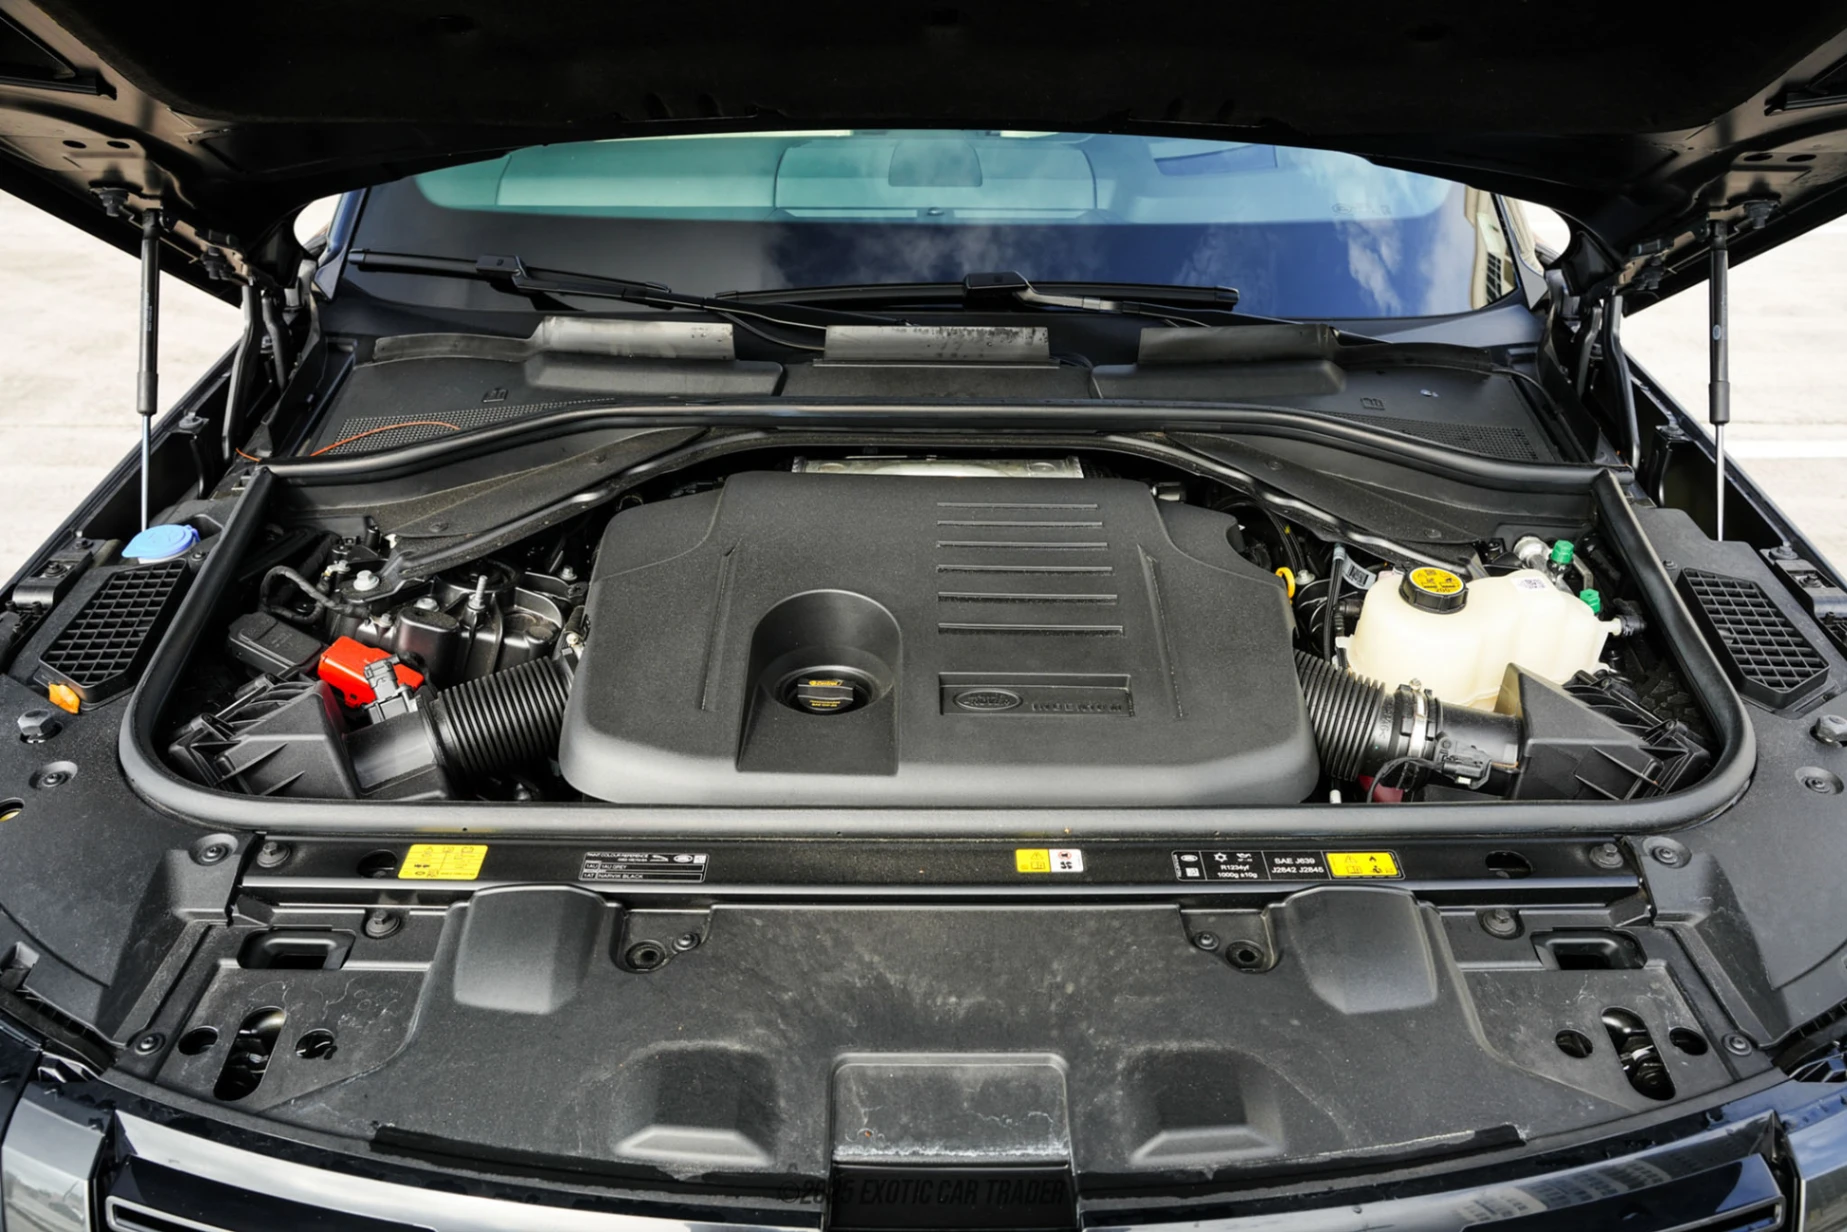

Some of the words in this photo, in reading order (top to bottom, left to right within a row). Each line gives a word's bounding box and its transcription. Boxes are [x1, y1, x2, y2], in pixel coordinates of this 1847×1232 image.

[1274, 857, 1294, 865] SAE
[1295, 857, 1316, 865] J639
[1220, 864, 1249, 872] R1234yf
